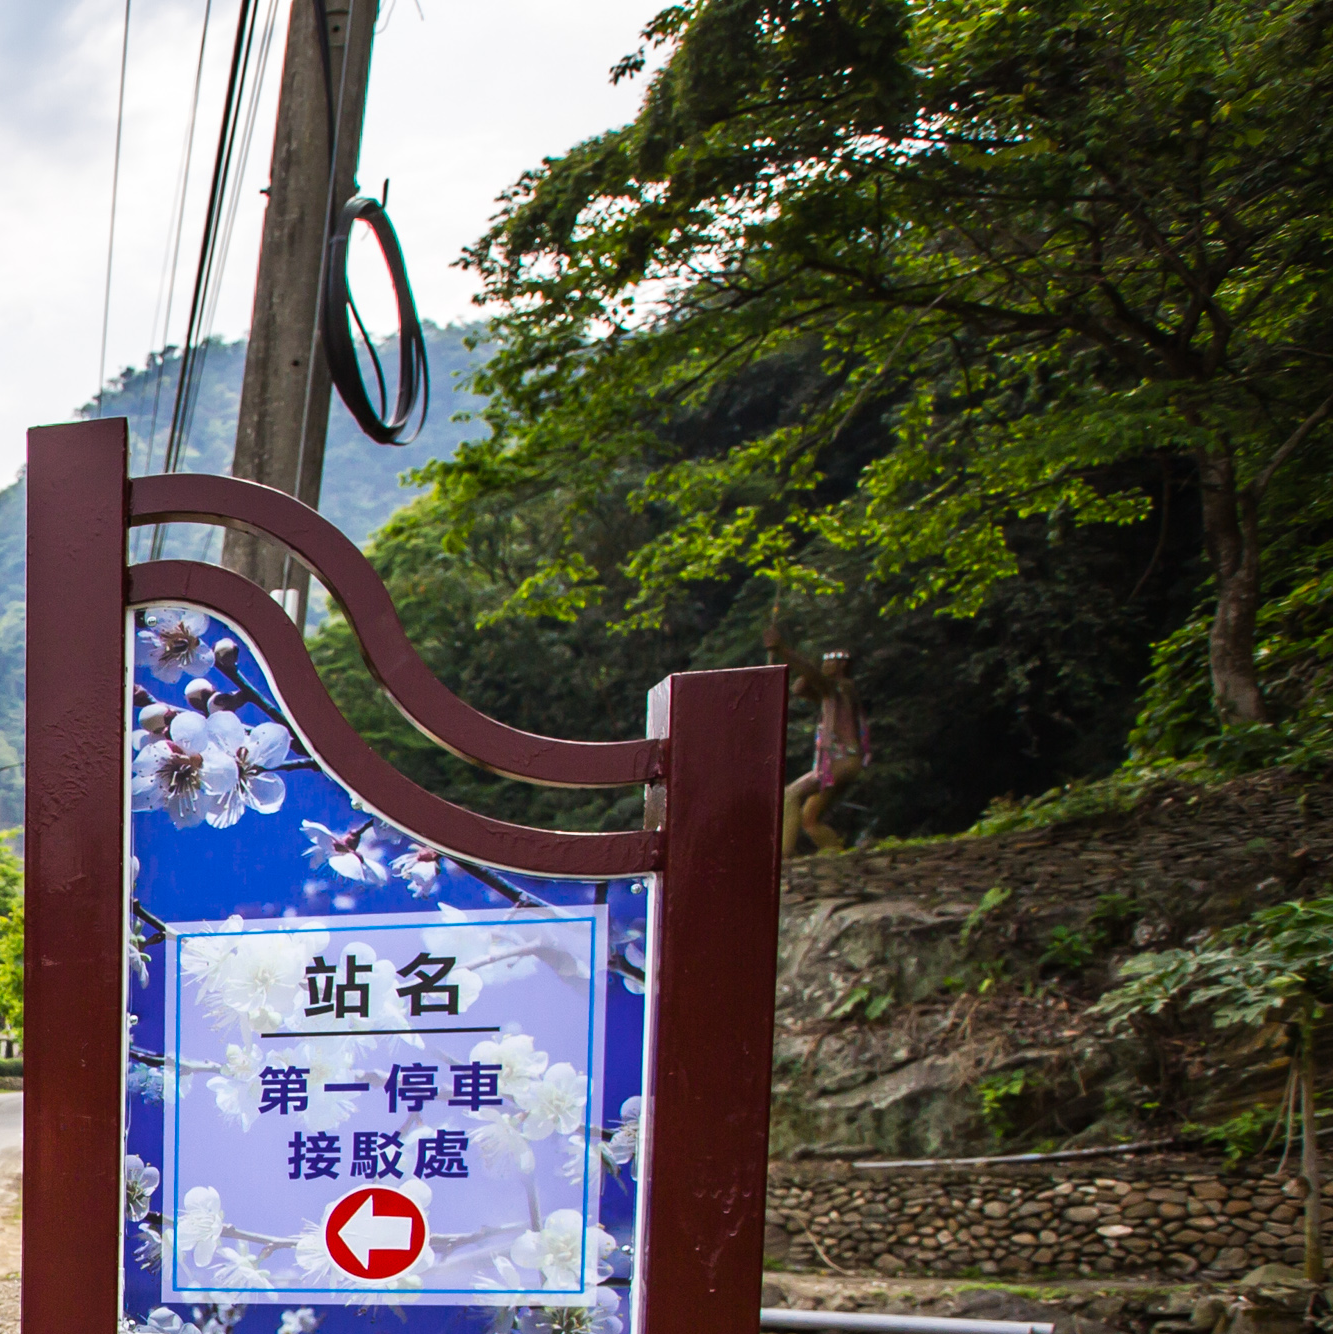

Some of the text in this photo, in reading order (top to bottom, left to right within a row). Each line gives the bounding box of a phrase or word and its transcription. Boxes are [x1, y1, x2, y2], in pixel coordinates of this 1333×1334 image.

[304, 952, 460, 1019] 站名
[258, 1061, 503, 1115] 第一停車
[287, 1129, 470, 1181] 接駁處
